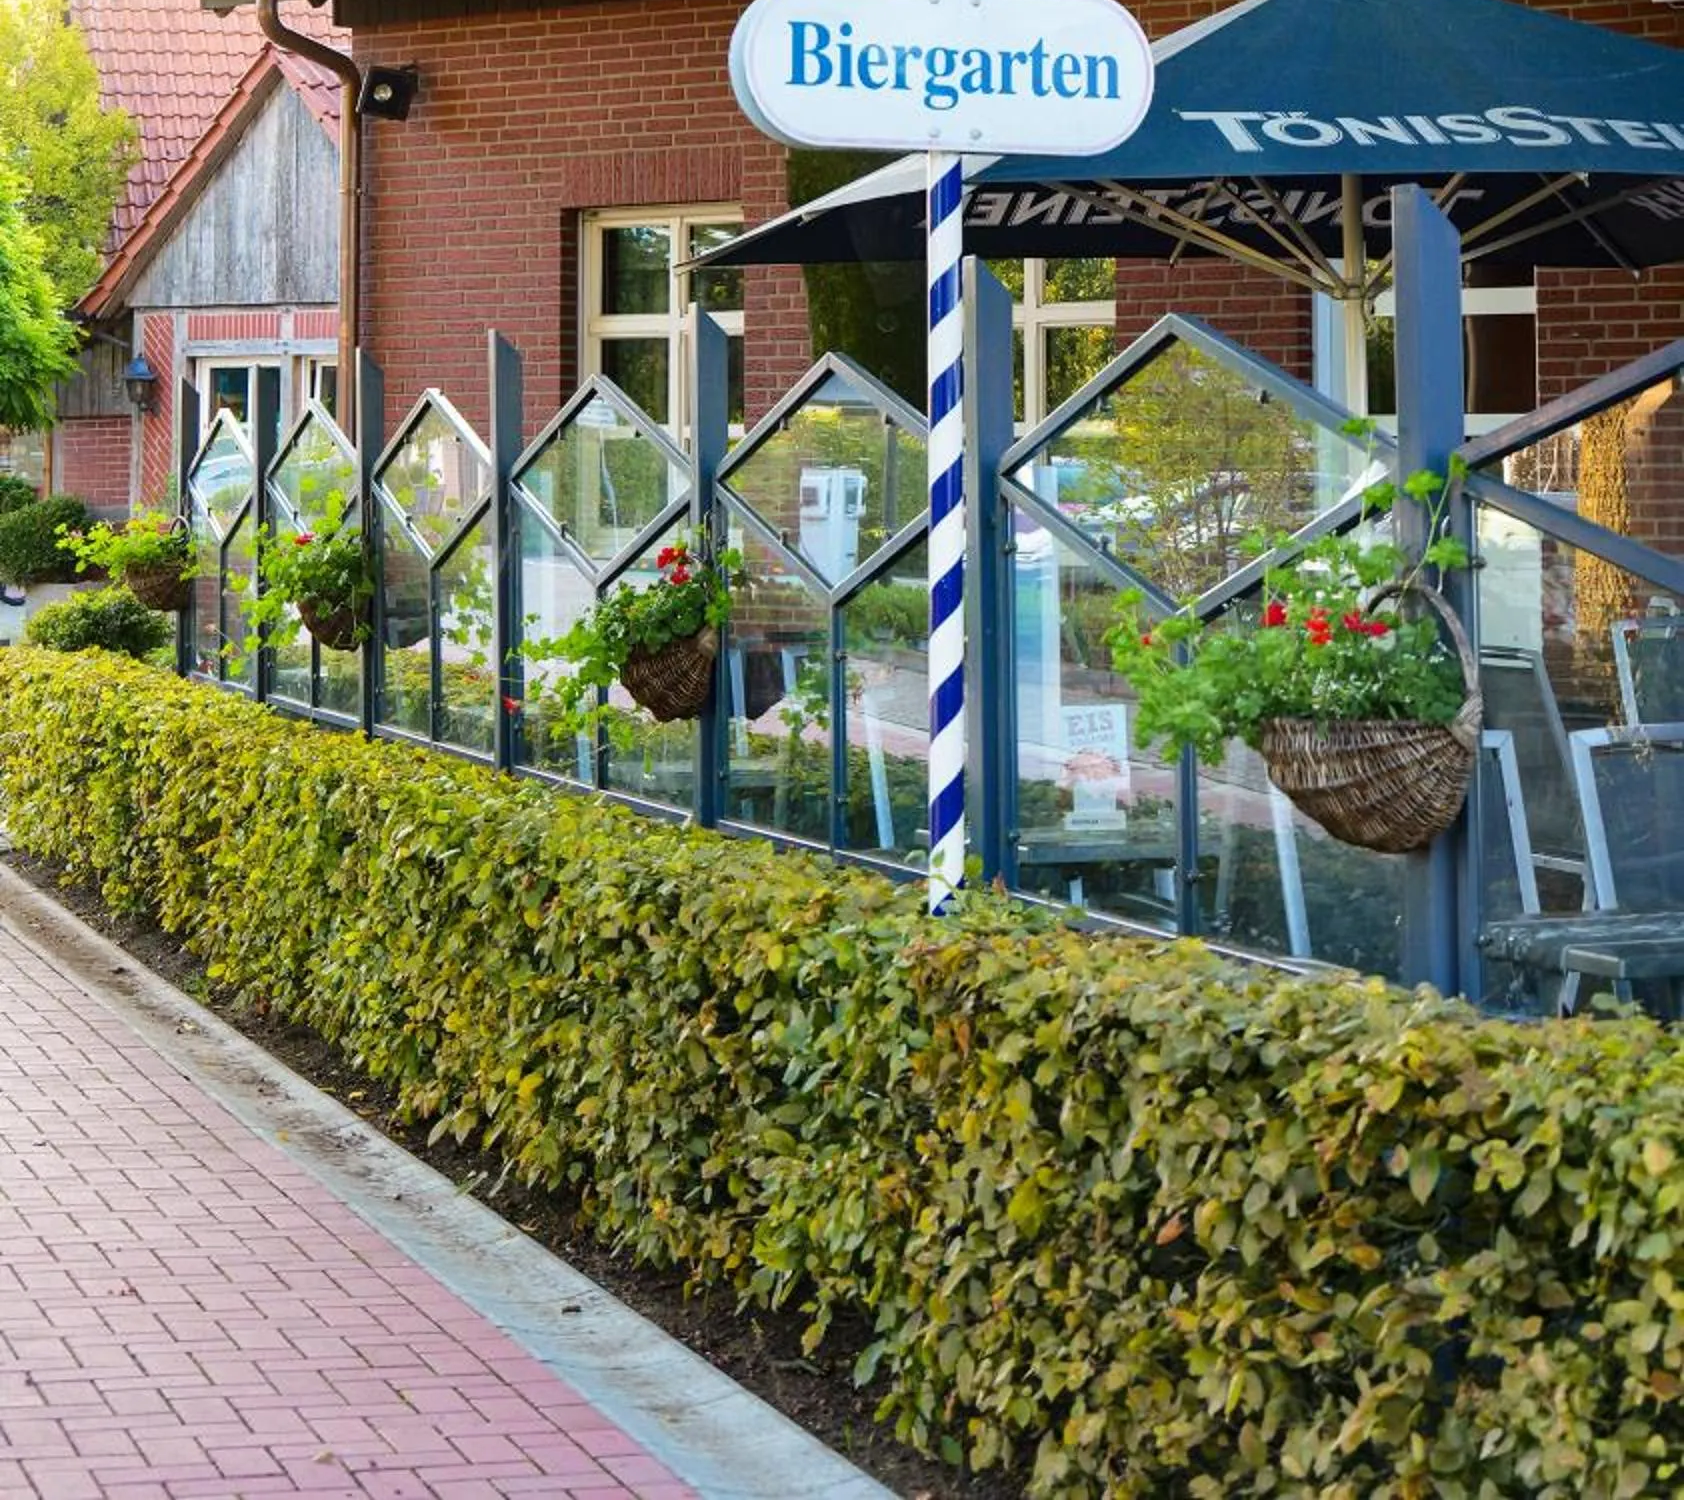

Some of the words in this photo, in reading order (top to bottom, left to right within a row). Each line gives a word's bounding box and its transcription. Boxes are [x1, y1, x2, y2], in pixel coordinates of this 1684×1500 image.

[785, 20, 1121, 111] Biergarten
[1172, 106, 1684, 153] TÖNISSTEI
[1066, 709, 1115, 737] EIS
